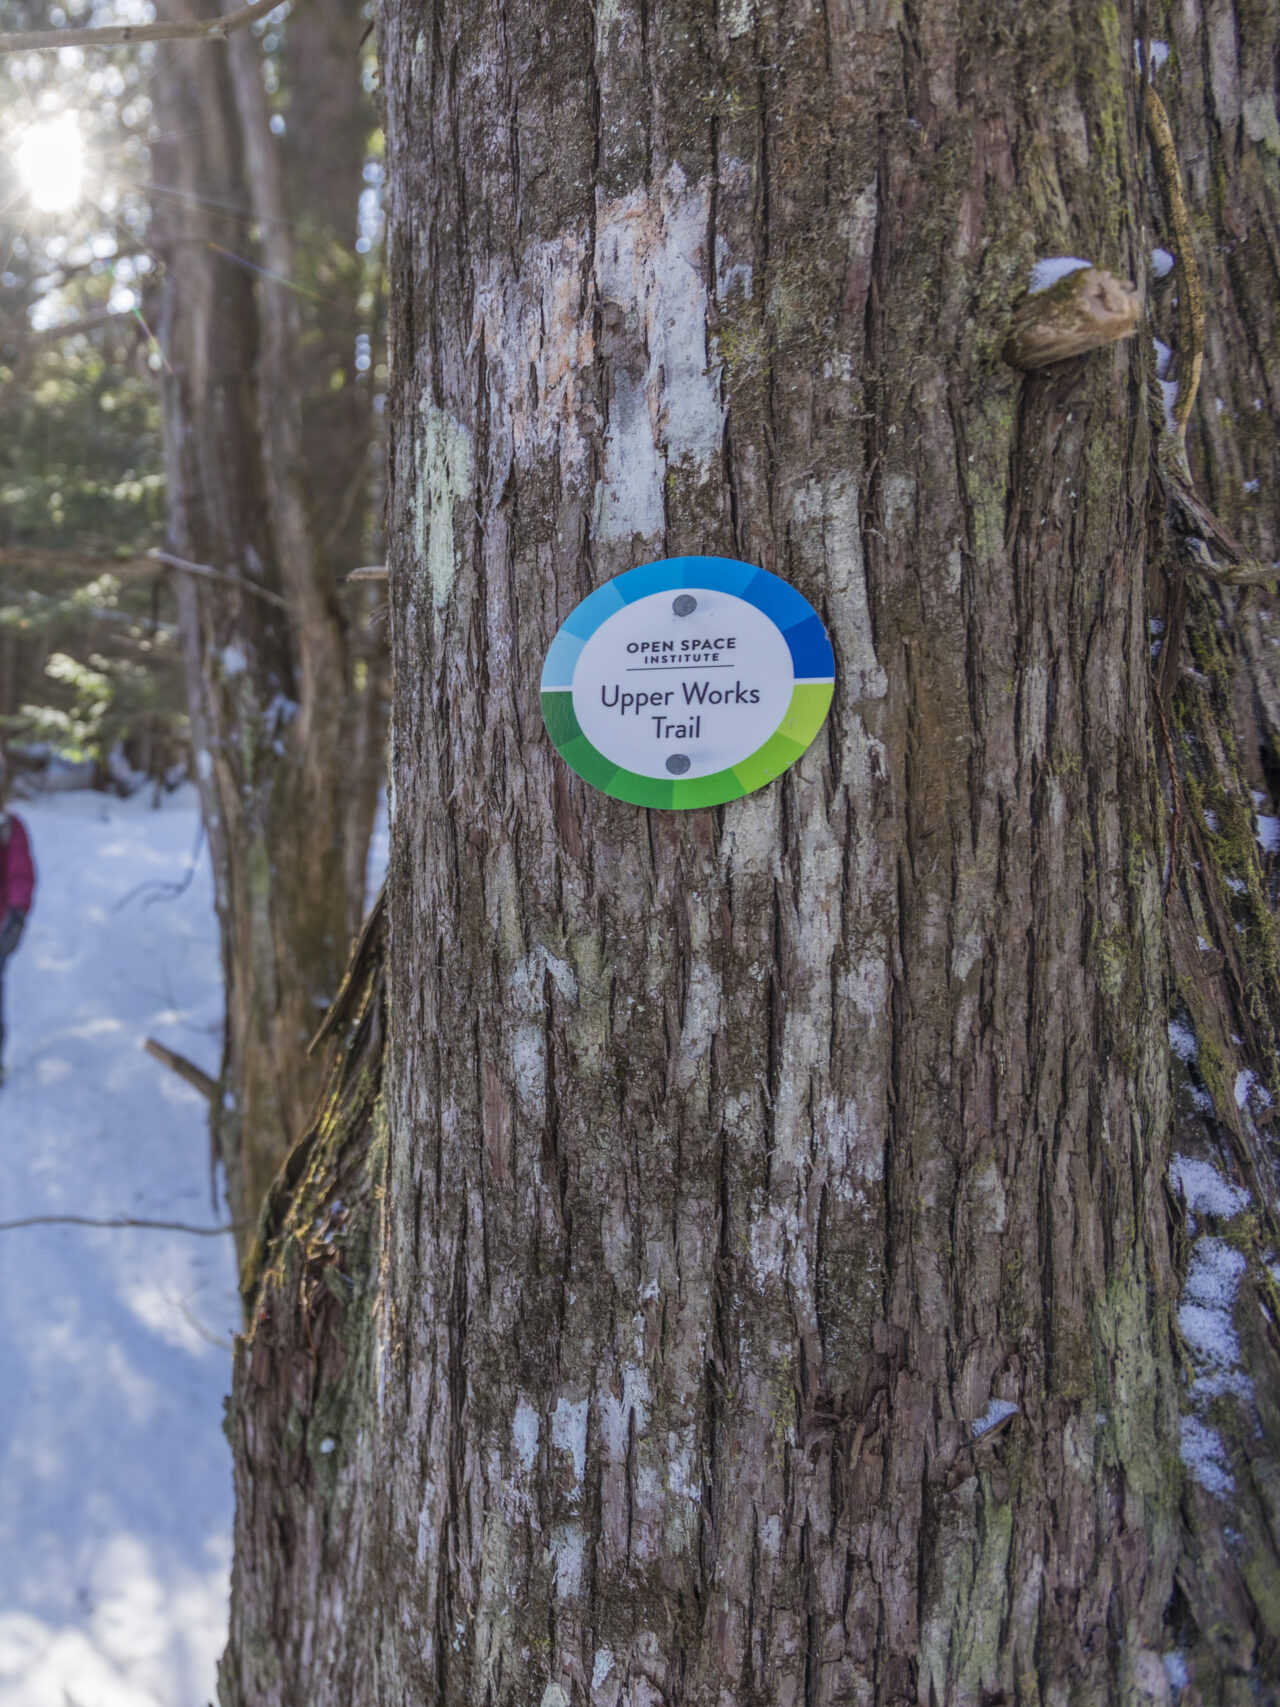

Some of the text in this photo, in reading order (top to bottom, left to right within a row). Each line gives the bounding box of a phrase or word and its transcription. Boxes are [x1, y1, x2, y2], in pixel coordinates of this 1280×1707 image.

[626, 637, 737, 654] OPEN SPACE
[644, 653, 720, 664] INSTITUTE
[601, 681, 760, 715] Upper Works
[652, 715, 701, 739] Trail
